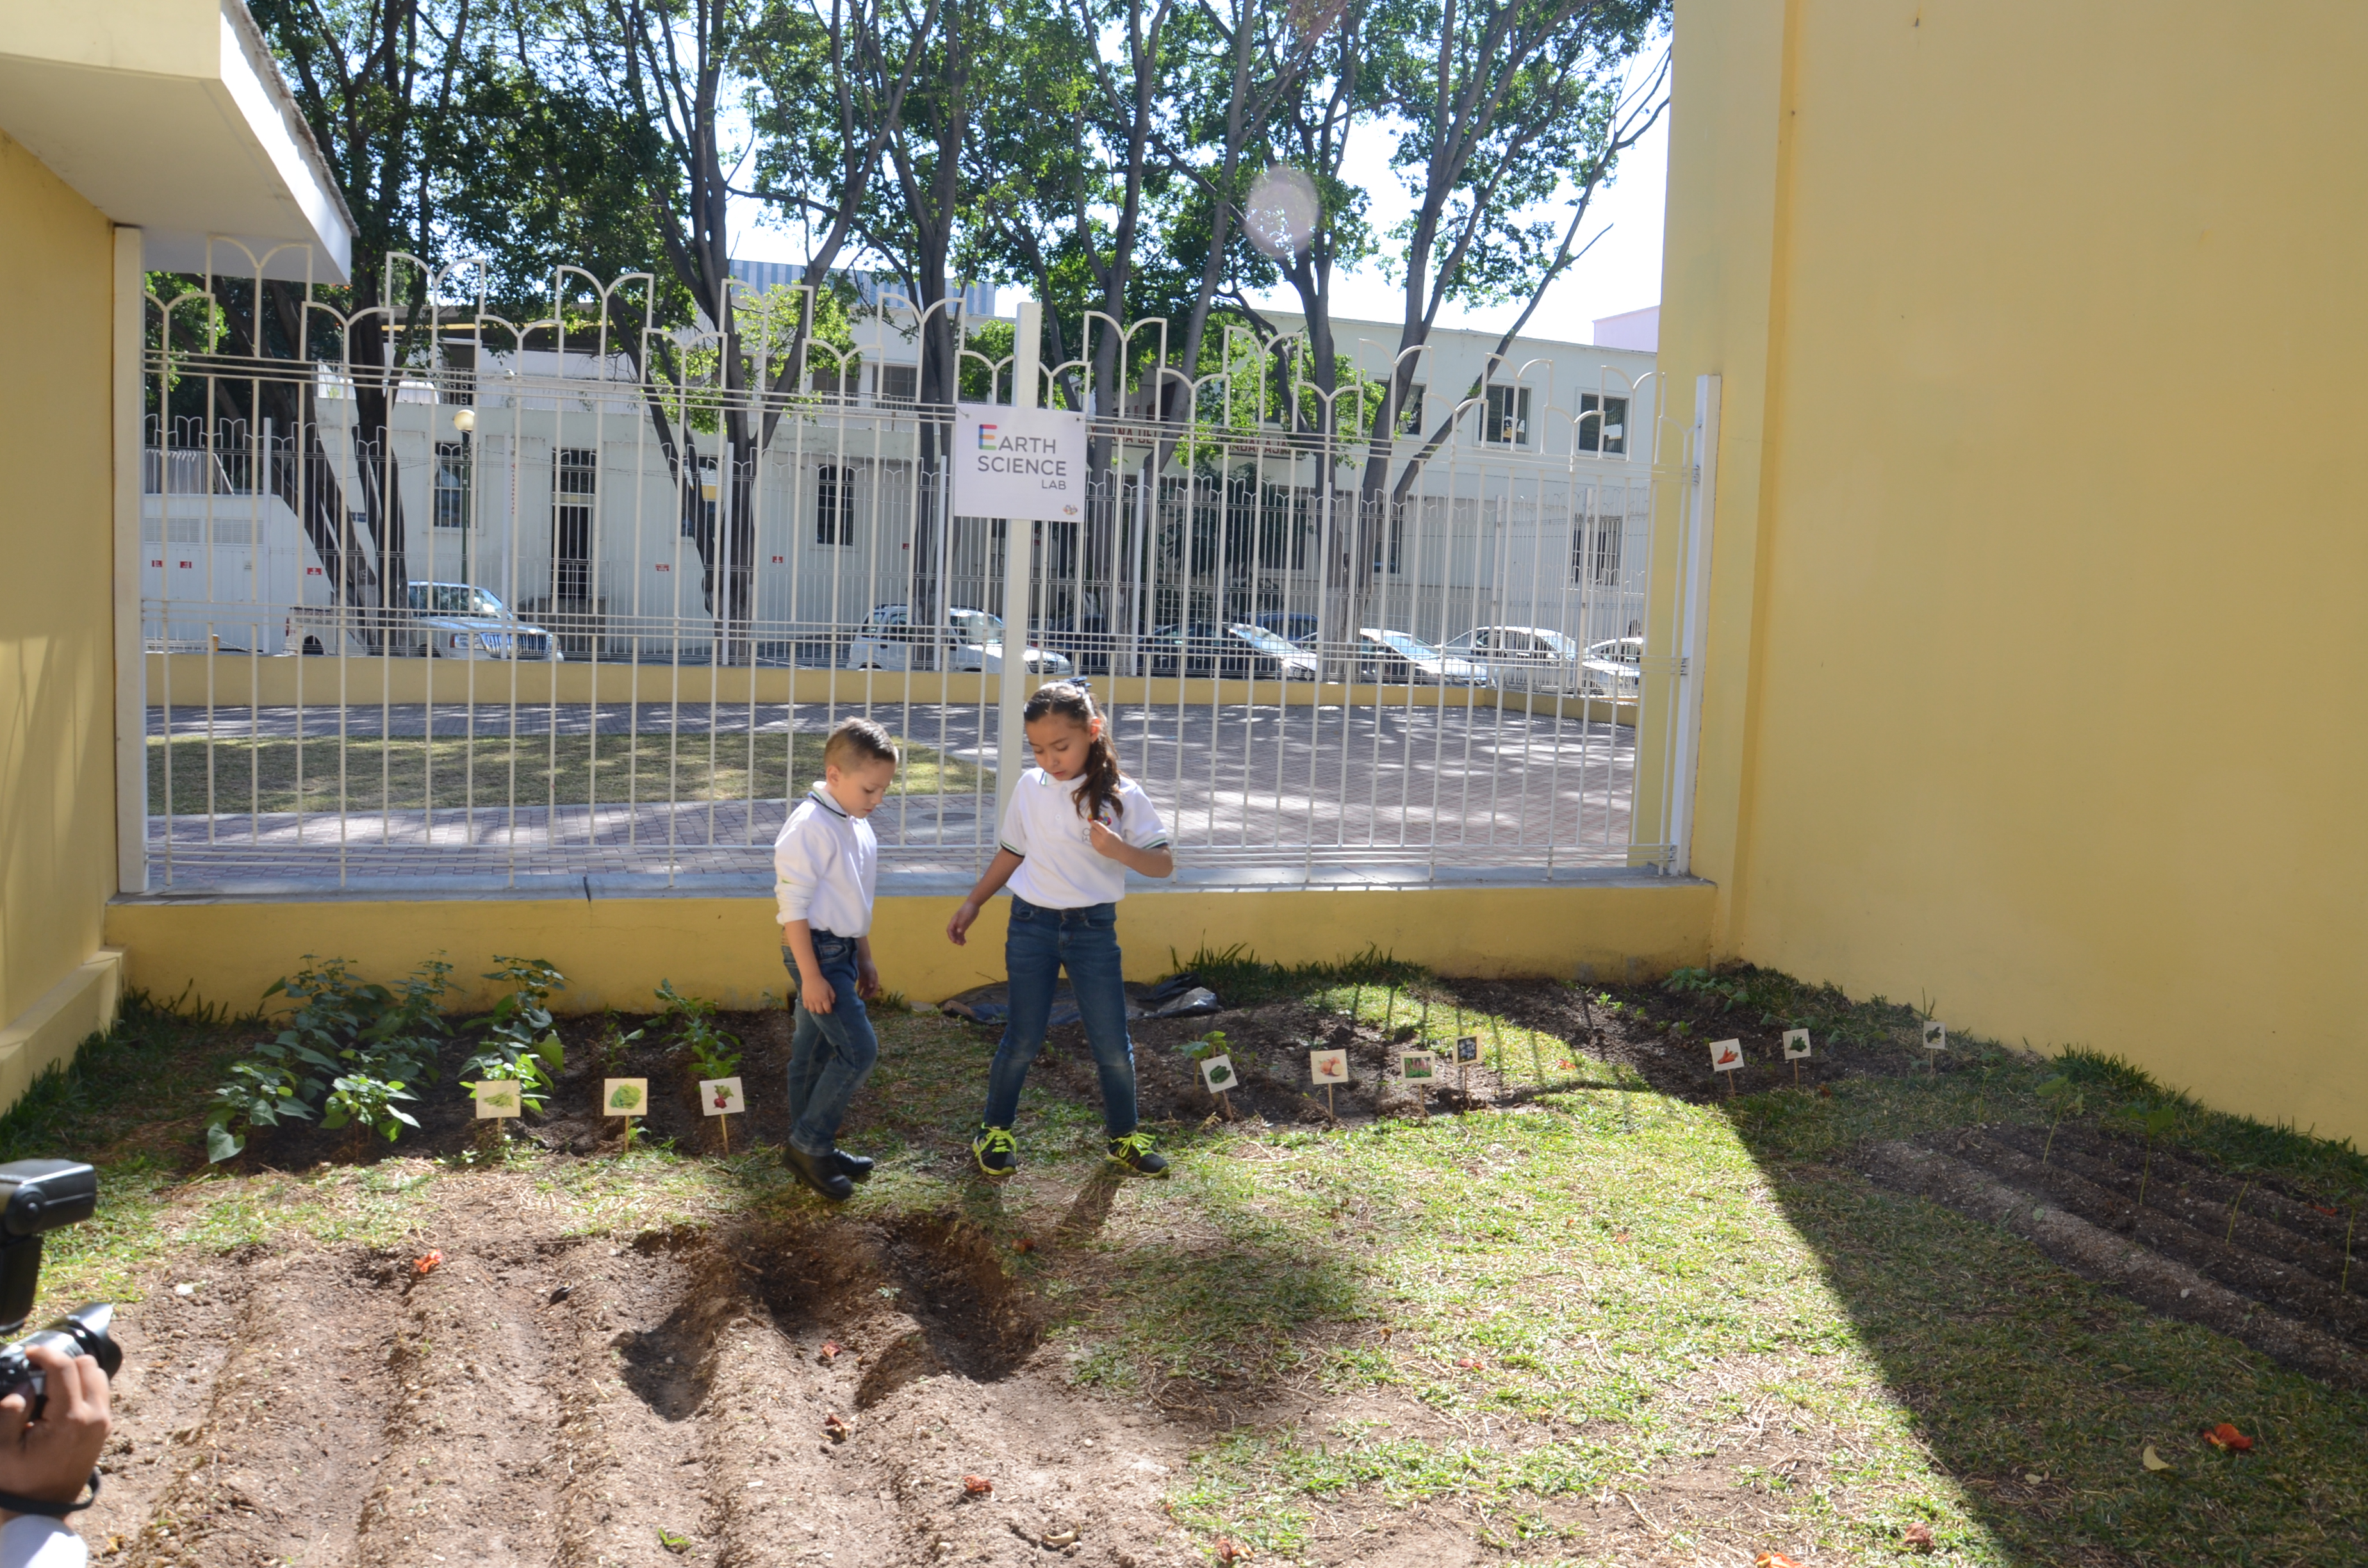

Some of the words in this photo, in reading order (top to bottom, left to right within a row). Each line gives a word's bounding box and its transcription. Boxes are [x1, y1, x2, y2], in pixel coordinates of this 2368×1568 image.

[978, 423, 1056, 454] EARTH
[978, 455, 1067, 477] SCIENCE
[1041, 479, 1066, 491] LAB
